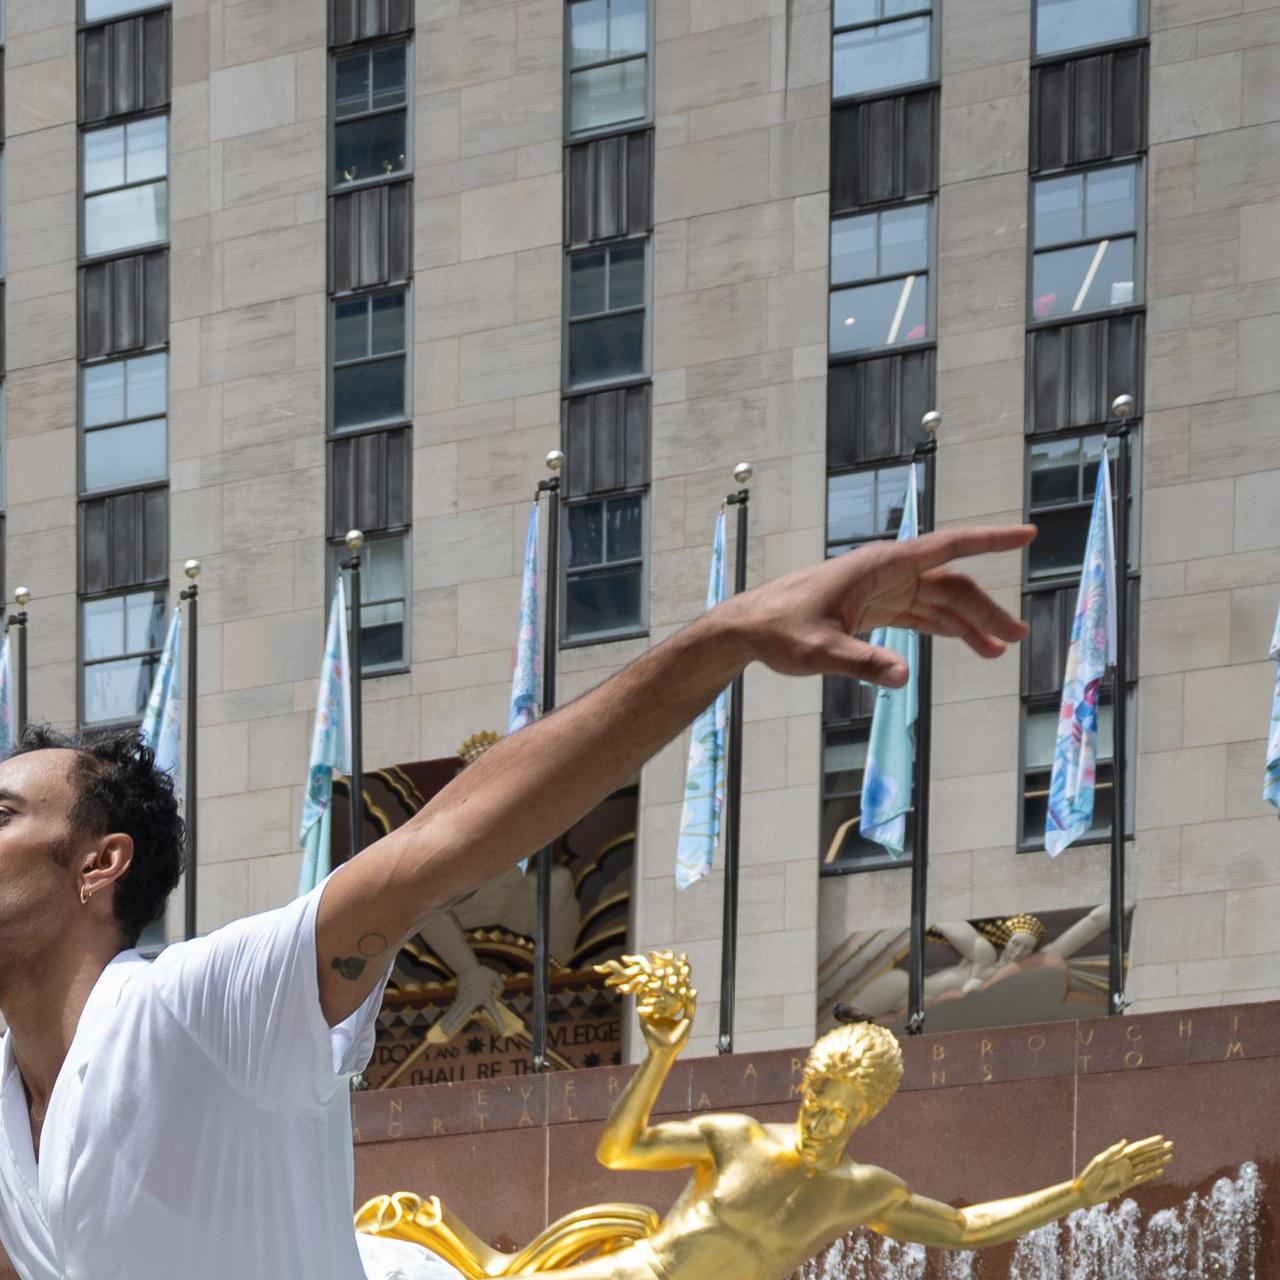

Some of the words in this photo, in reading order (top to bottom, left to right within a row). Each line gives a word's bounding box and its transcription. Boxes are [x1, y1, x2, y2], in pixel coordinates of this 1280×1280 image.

[490, 1021, 621, 1053] KNWLEDGE
[1079, 1051, 1143, 1073] TO
[477, 1076, 620, 1105] EVER
